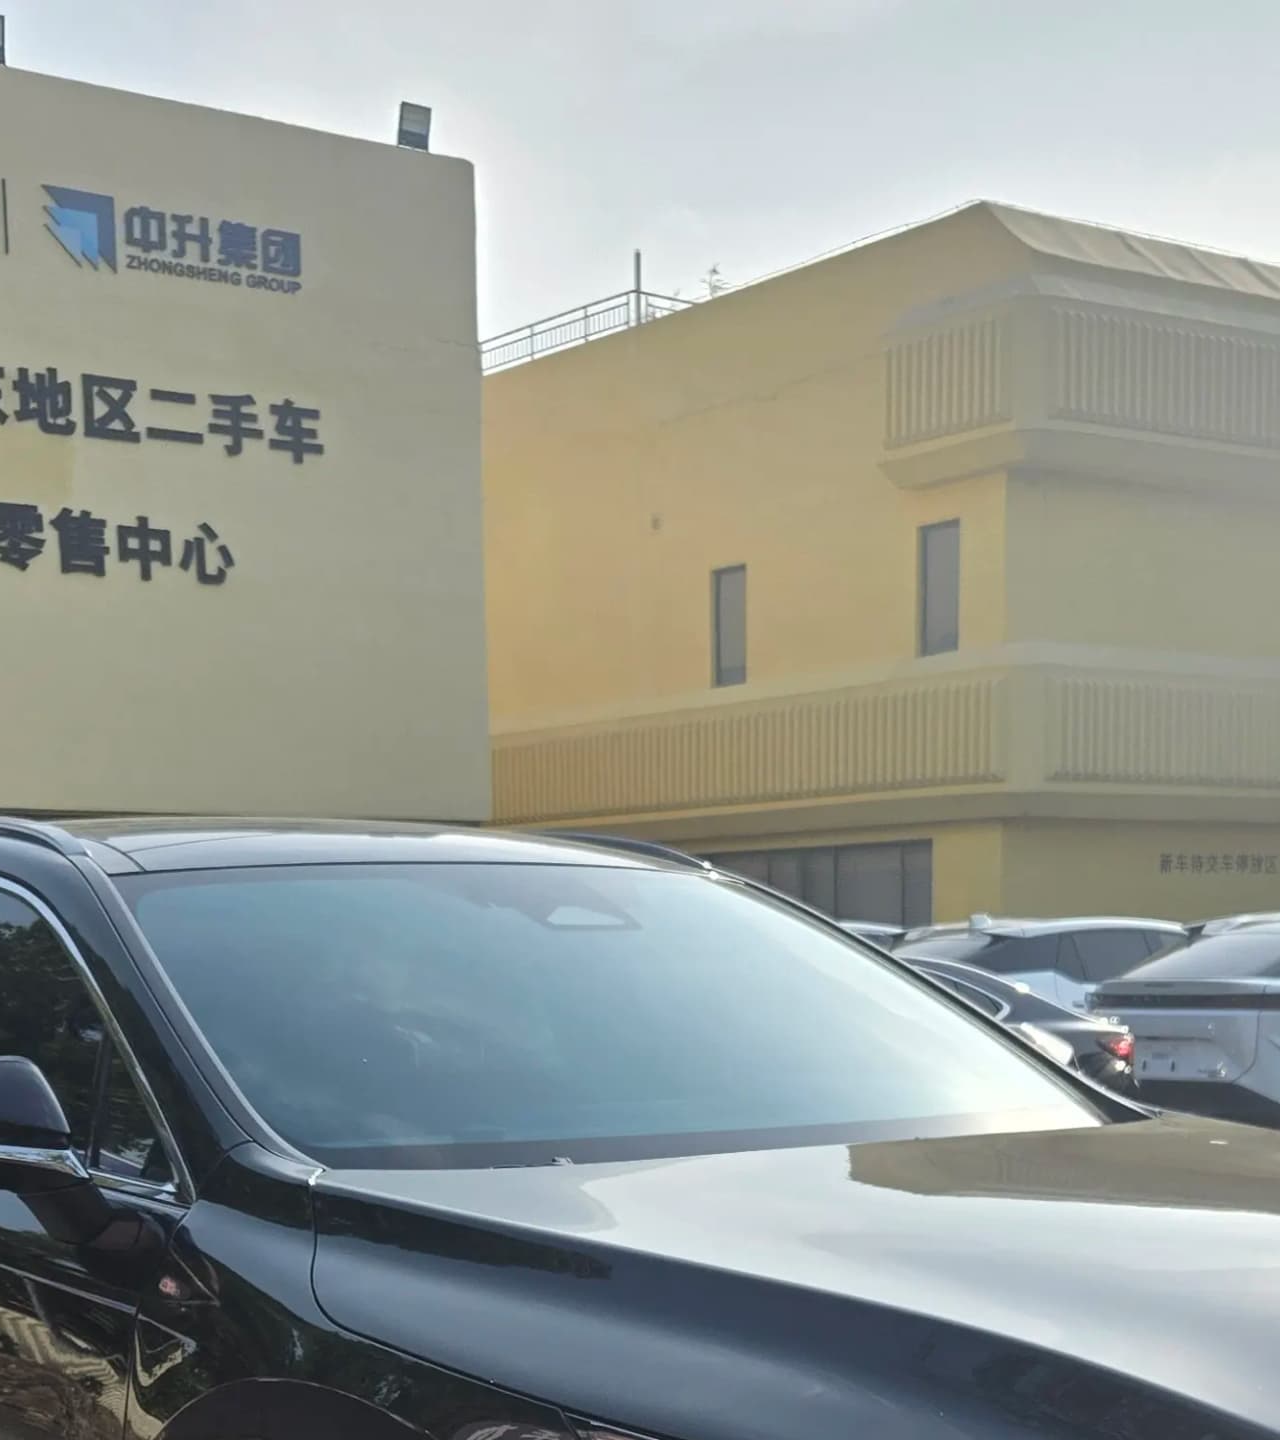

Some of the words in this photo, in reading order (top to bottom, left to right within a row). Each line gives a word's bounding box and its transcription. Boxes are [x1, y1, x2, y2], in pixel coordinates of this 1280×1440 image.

[123, 205, 302, 278] 中升集团
[125, 253, 243, 287] ZHONGSHENG
[245, 272, 303, 295] GROUP
